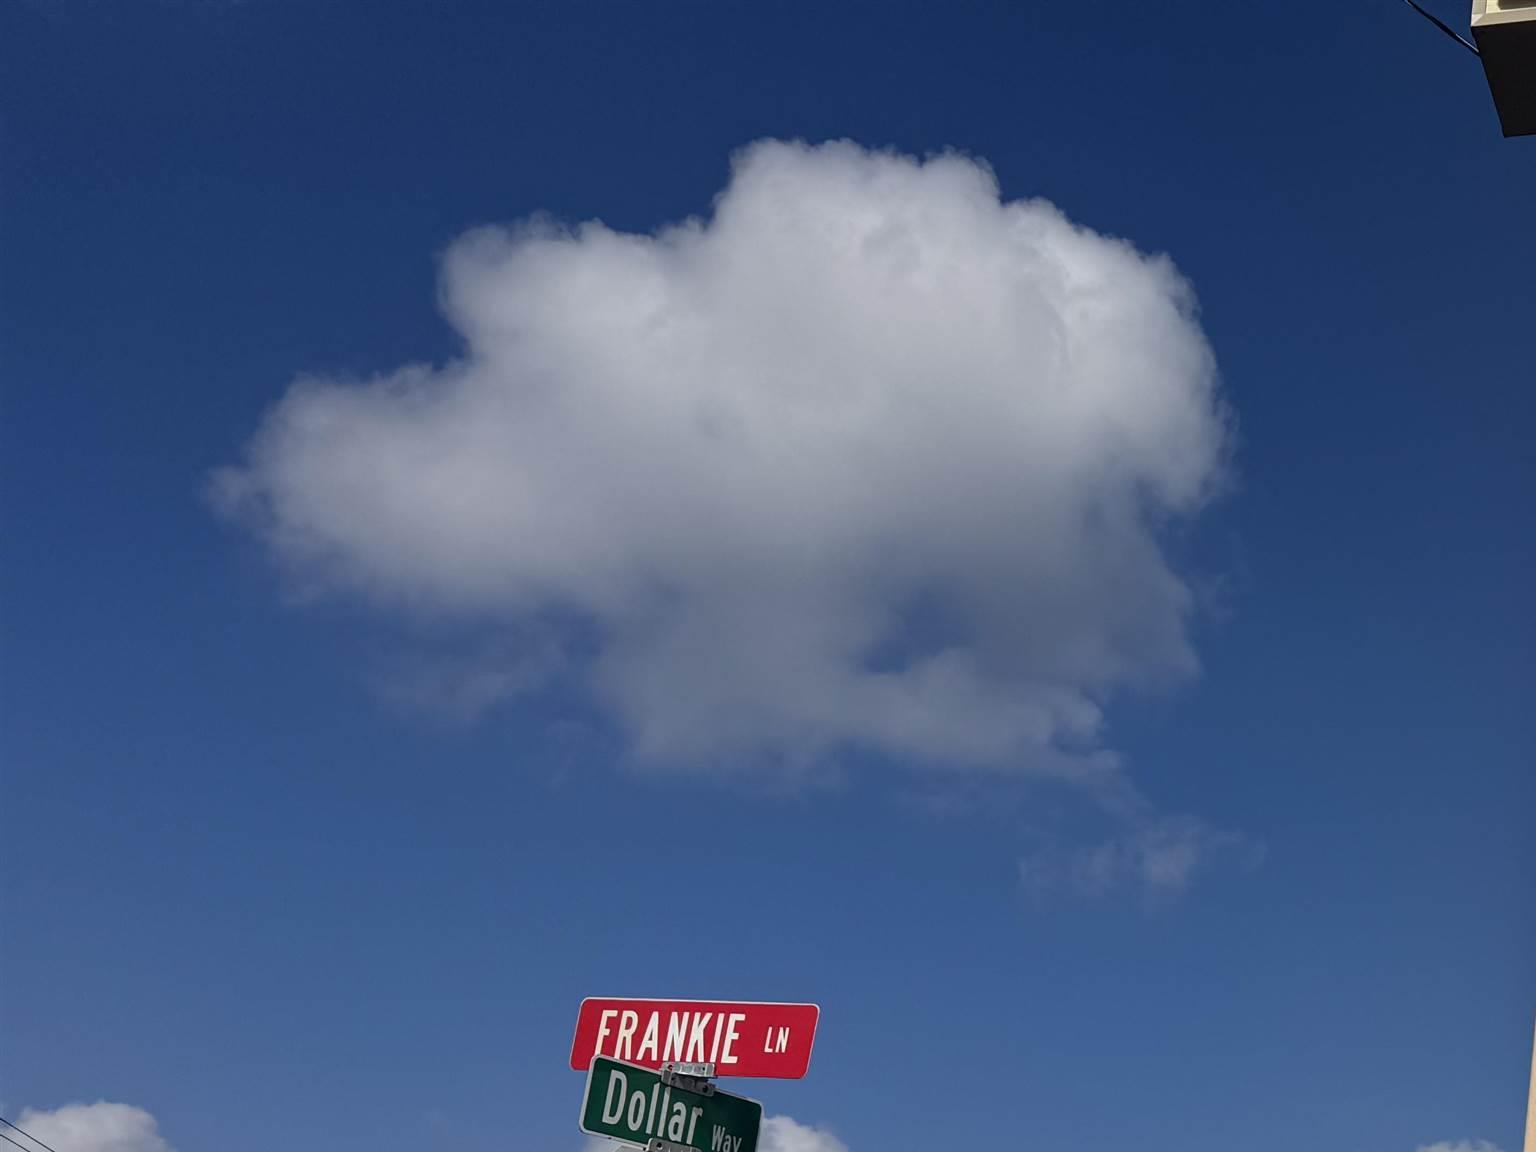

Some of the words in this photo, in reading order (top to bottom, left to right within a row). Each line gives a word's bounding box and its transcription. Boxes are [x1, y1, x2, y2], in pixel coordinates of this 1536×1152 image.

[595, 1009, 746, 1064] FRANKIE
[764, 1026, 790, 1053] LN
[602, 1069, 703, 1145] Dollar
